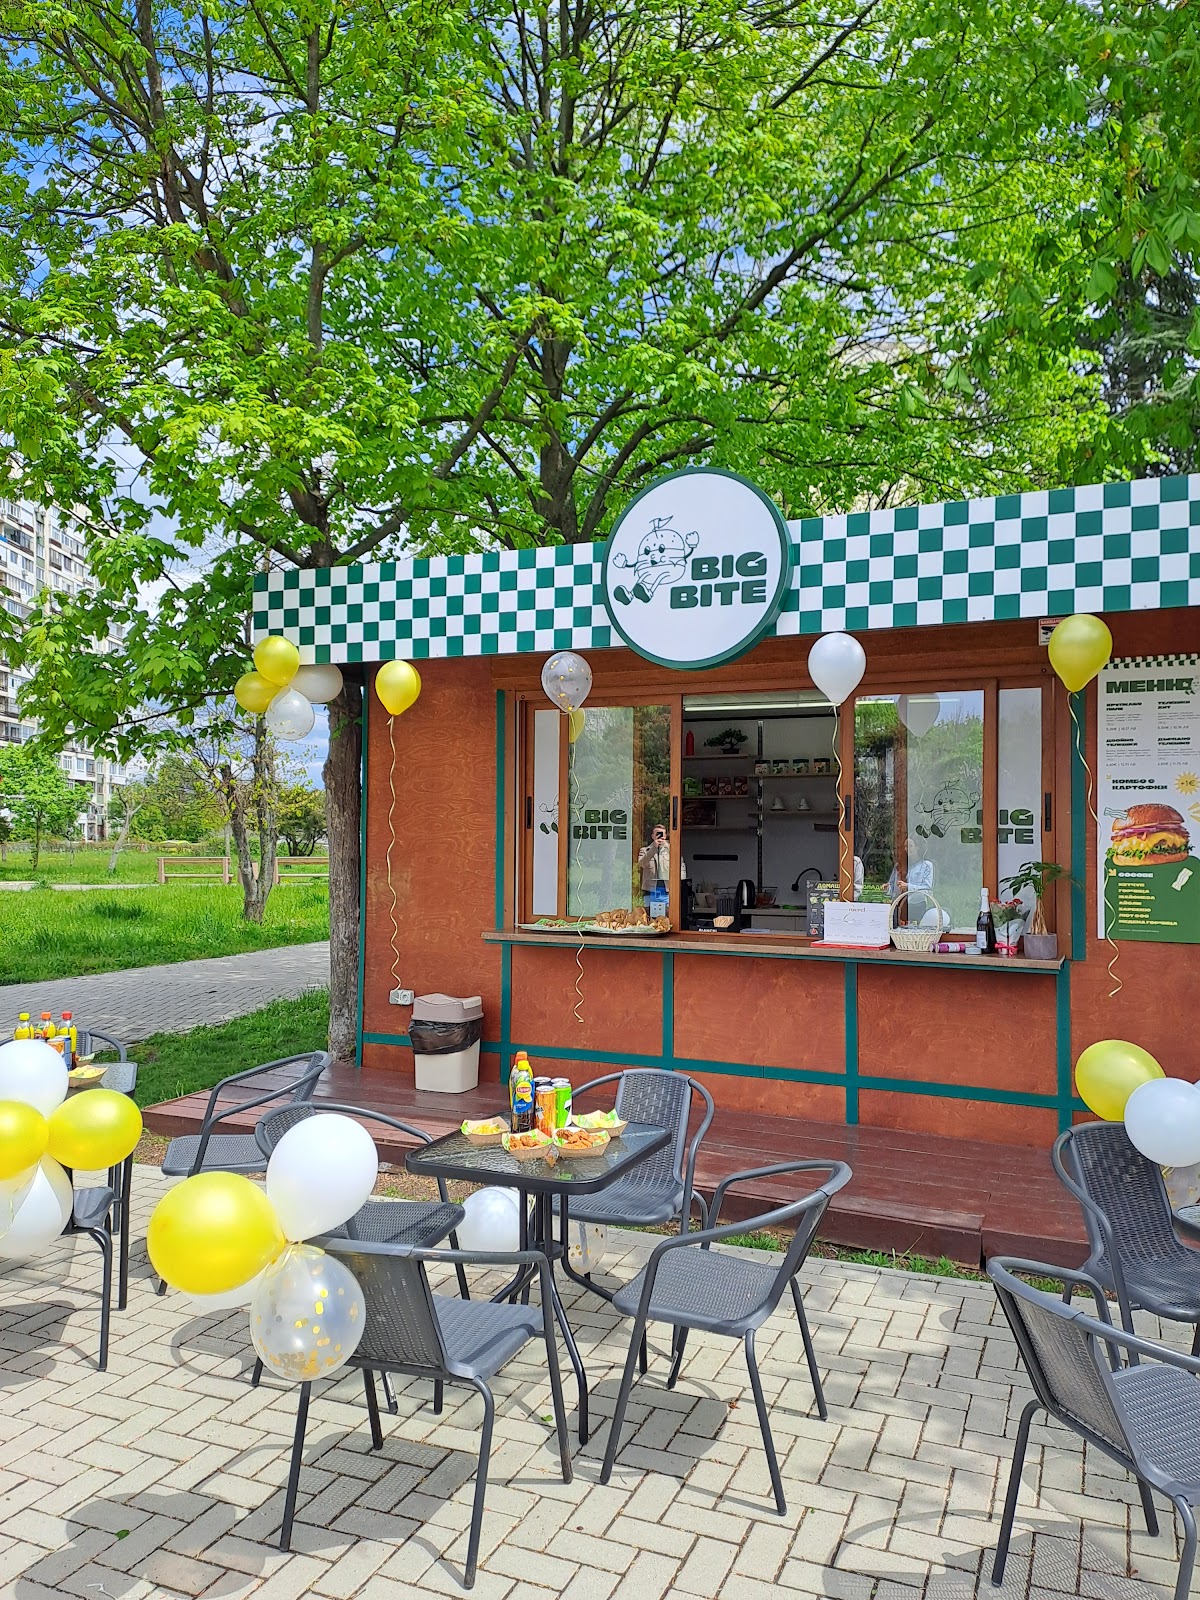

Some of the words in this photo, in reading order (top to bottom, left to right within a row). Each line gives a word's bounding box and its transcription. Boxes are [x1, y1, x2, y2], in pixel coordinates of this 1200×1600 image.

[691, 551, 767, 580] BIG
[670, 579, 767, 609] BITE
[1106, 678, 1194, 694] МЕНЮ
[584, 809, 627, 824] BIG
[976, 808, 1034, 826] IG
[573, 825, 627, 840] BITE
[961, 828, 1034, 844] BTE
